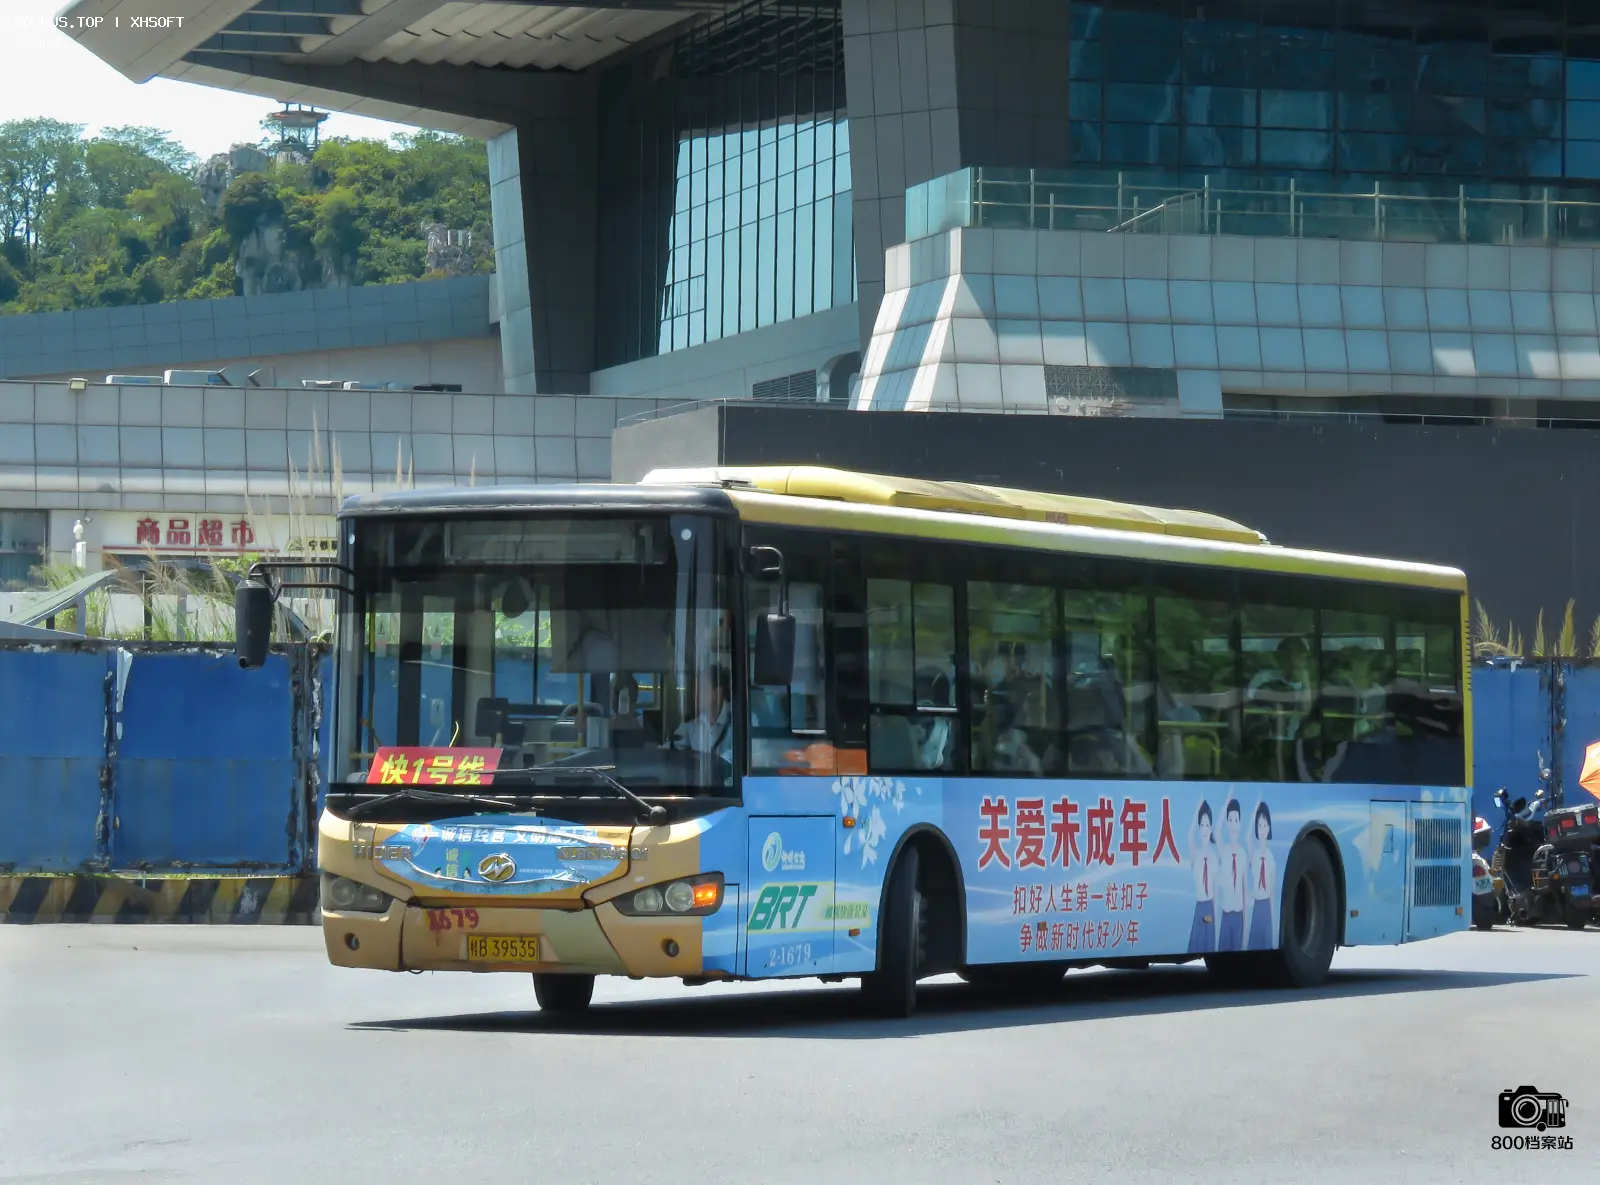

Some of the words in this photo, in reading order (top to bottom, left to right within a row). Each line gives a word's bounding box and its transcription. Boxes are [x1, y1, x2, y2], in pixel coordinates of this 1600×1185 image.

[137, 518, 254, 547] 商品超市
[381, 753, 485, 785] 快1号线
[978, 796, 1181, 870] 关爱未成年人
[749, 885, 818, 930] BRT
[1012, 882, 1149, 915] 扣好人生第一粒扣子
[493, 940, 537, 958] 39535
[1018, 919, 1140, 953] 争做新时代好少年
